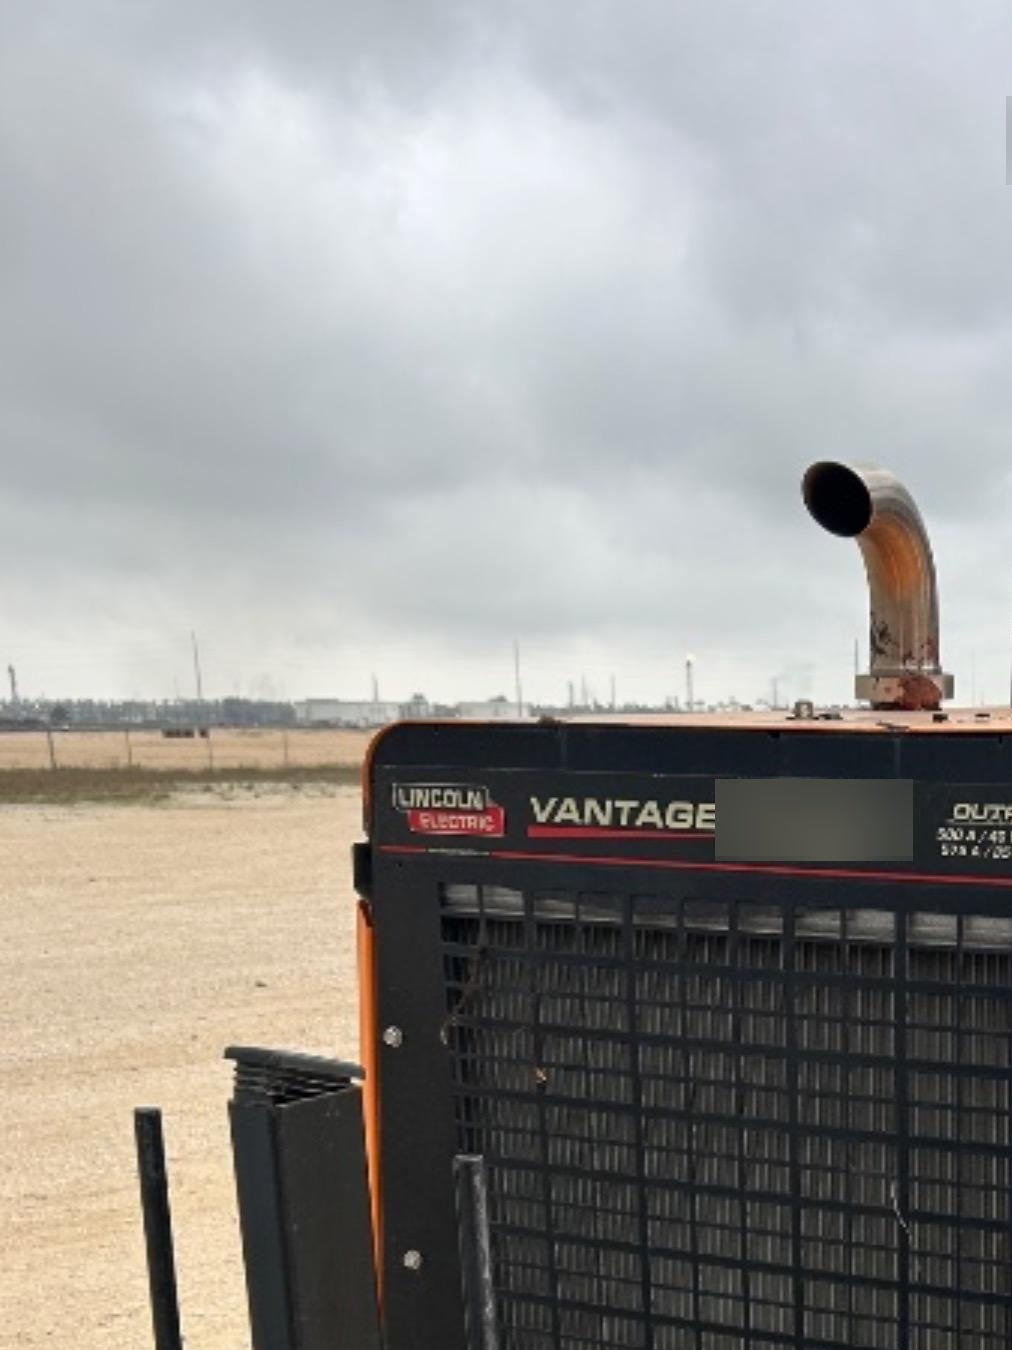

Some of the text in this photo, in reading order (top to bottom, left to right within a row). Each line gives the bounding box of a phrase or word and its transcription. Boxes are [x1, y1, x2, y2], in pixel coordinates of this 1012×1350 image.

[398, 787, 484, 811] LINCOLN
[420, 812, 496, 831] ELECTRIC
[530, 797, 716, 830] VANTAGE
